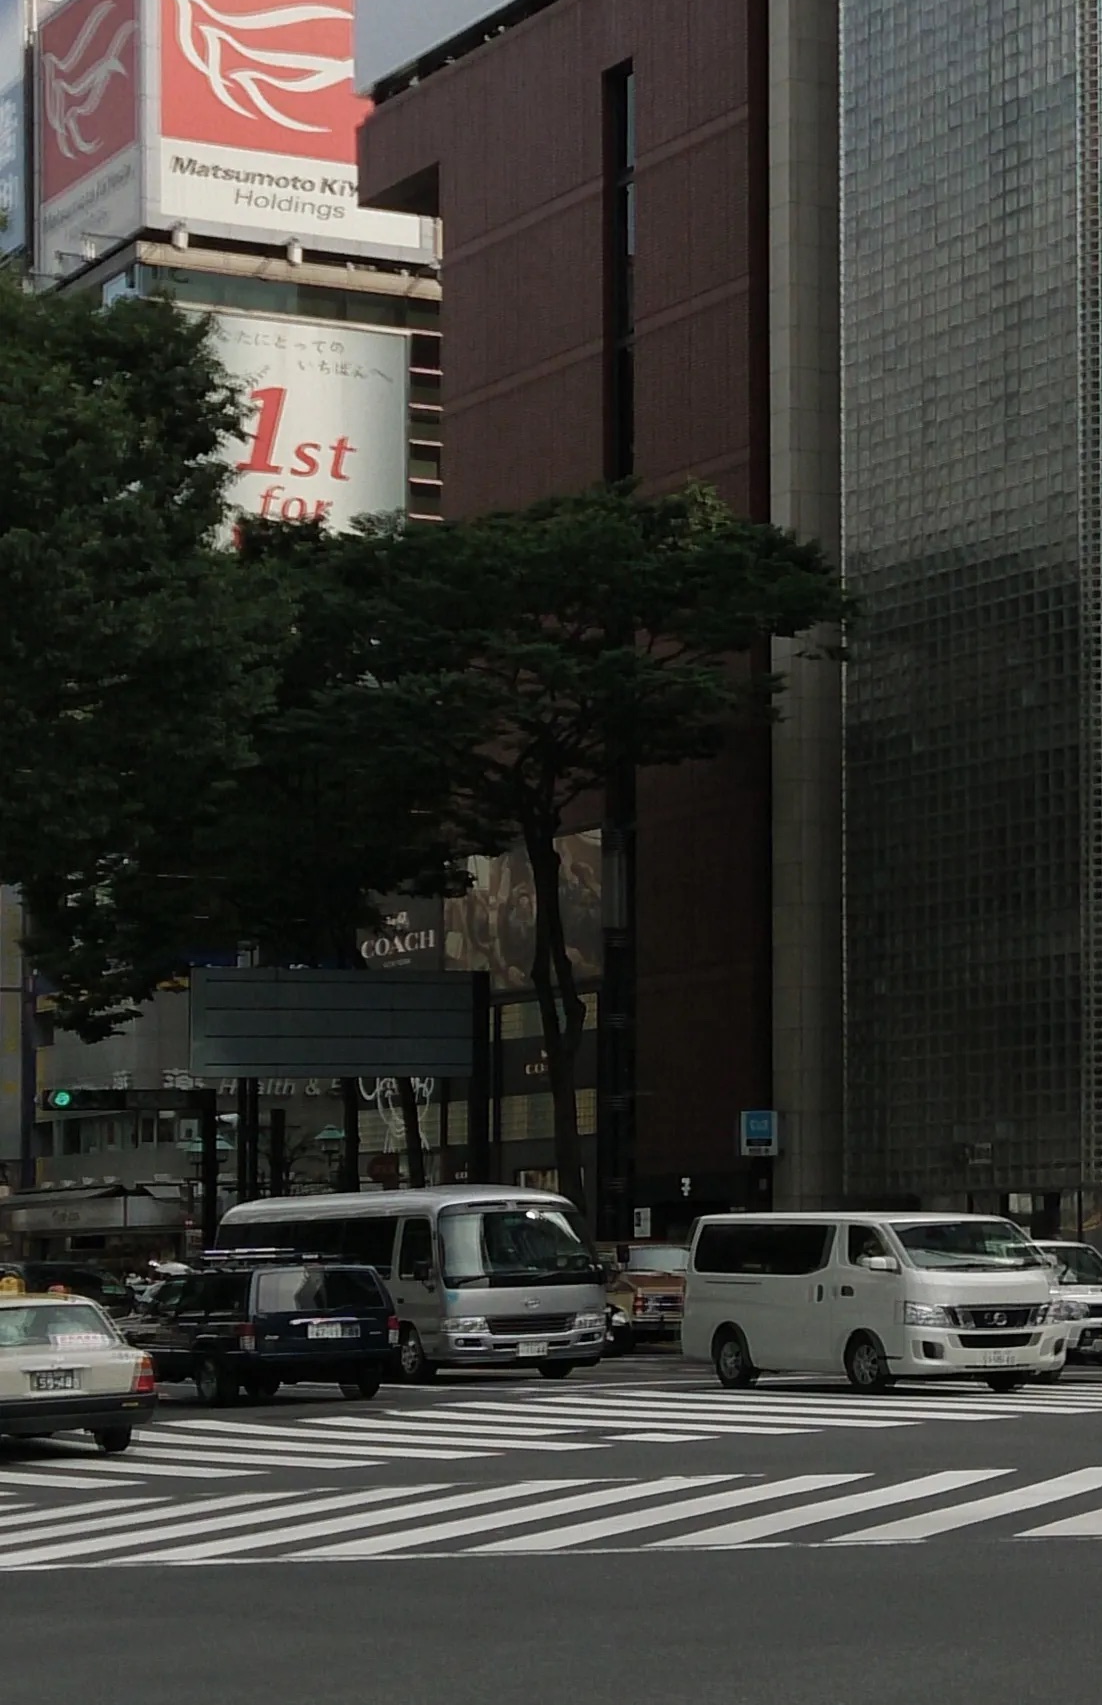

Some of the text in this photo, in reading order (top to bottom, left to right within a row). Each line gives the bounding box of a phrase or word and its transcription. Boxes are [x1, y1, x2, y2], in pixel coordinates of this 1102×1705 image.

[171, 155, 316, 193] Matsumoto
[234, 188, 346, 221] Holdings
[236, 386, 358, 482] 1st
[260, 485, 334, 522] for
[360, 929, 436, 959] COACH
